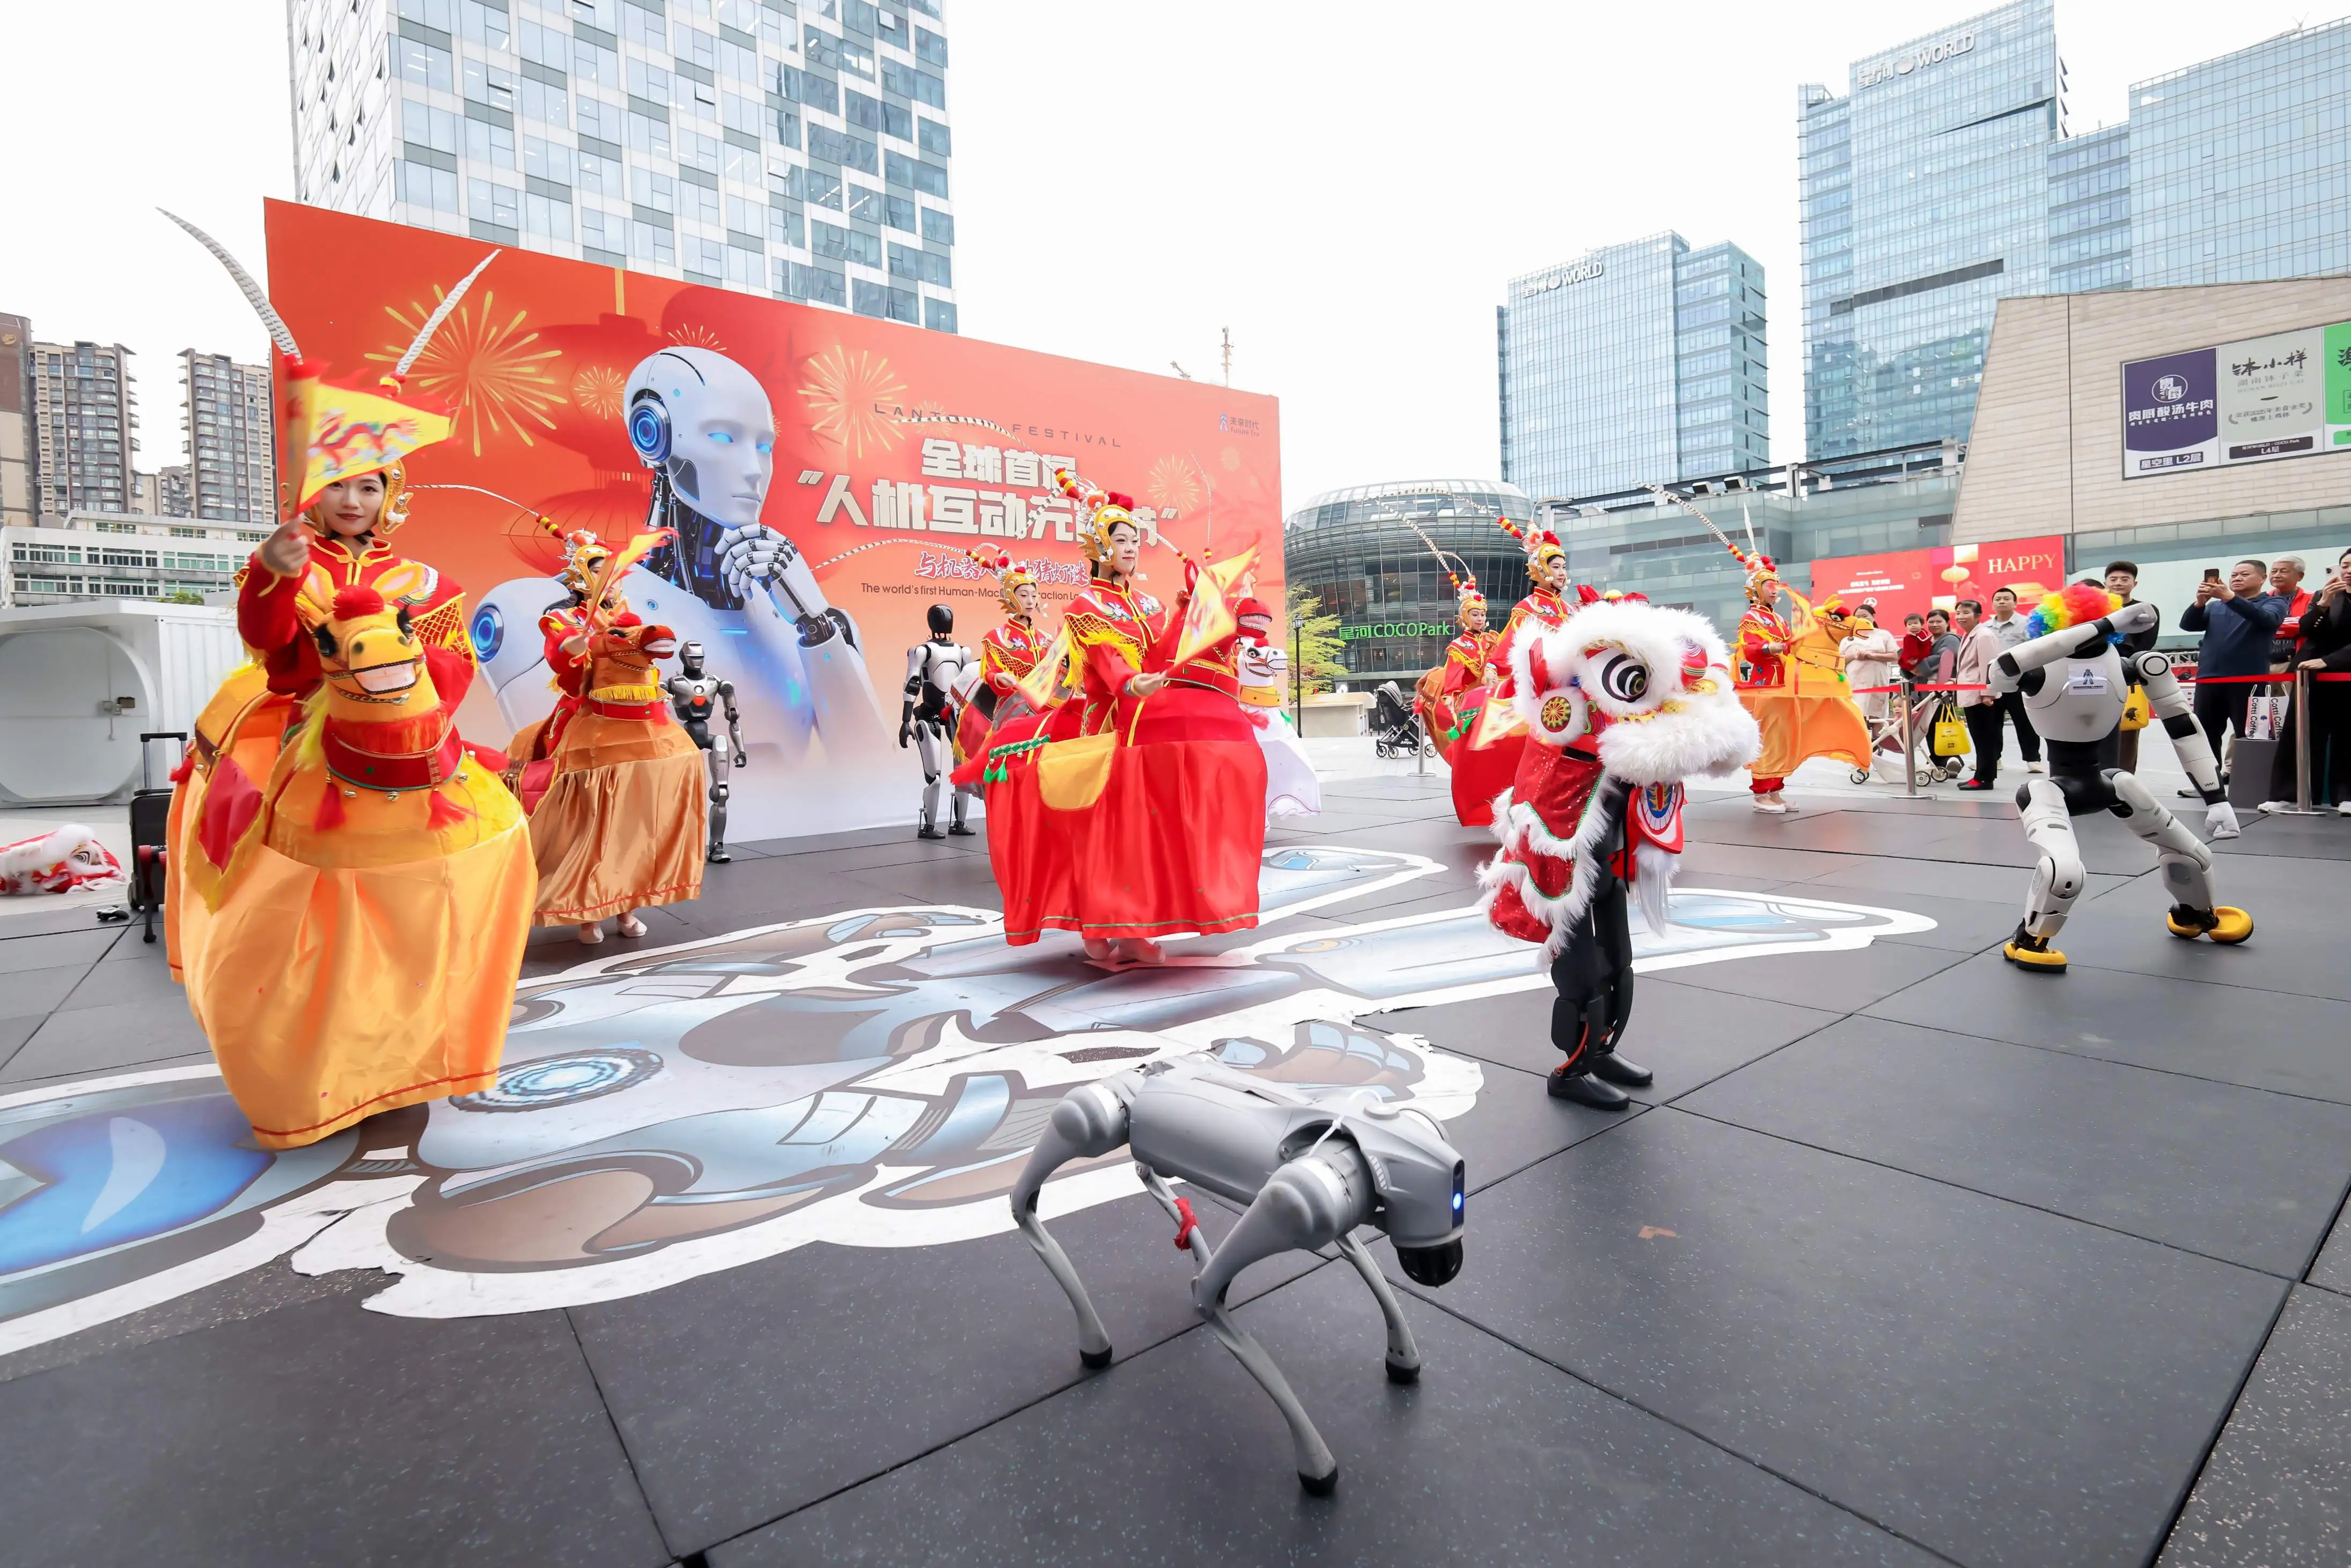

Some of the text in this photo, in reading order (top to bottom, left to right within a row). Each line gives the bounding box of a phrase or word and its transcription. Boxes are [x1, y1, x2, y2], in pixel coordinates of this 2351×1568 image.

[1917, 33, 1975, 68] WORLD
[1562, 262, 1603, 285] WORLD
[875, 403, 1121, 447] LANT FESTIVAL
[1230, 417, 1259, 430] 未来时代
[1231, 426, 1249, 435] Future
[2141, 453, 2201, 469] 星空里 L2层
[914, 551, 1090, 587] 与机器人猜灯谜
[1988, 554, 2056, 574] HAPPY
[861, 583, 879, 593] The
[920, 585, 937, 595] first
[1038, 591, 1068, 600] action
[2271, 698, 2280, 715] Cotti
[2249, 697, 2259, 738] Cotti Coffee
